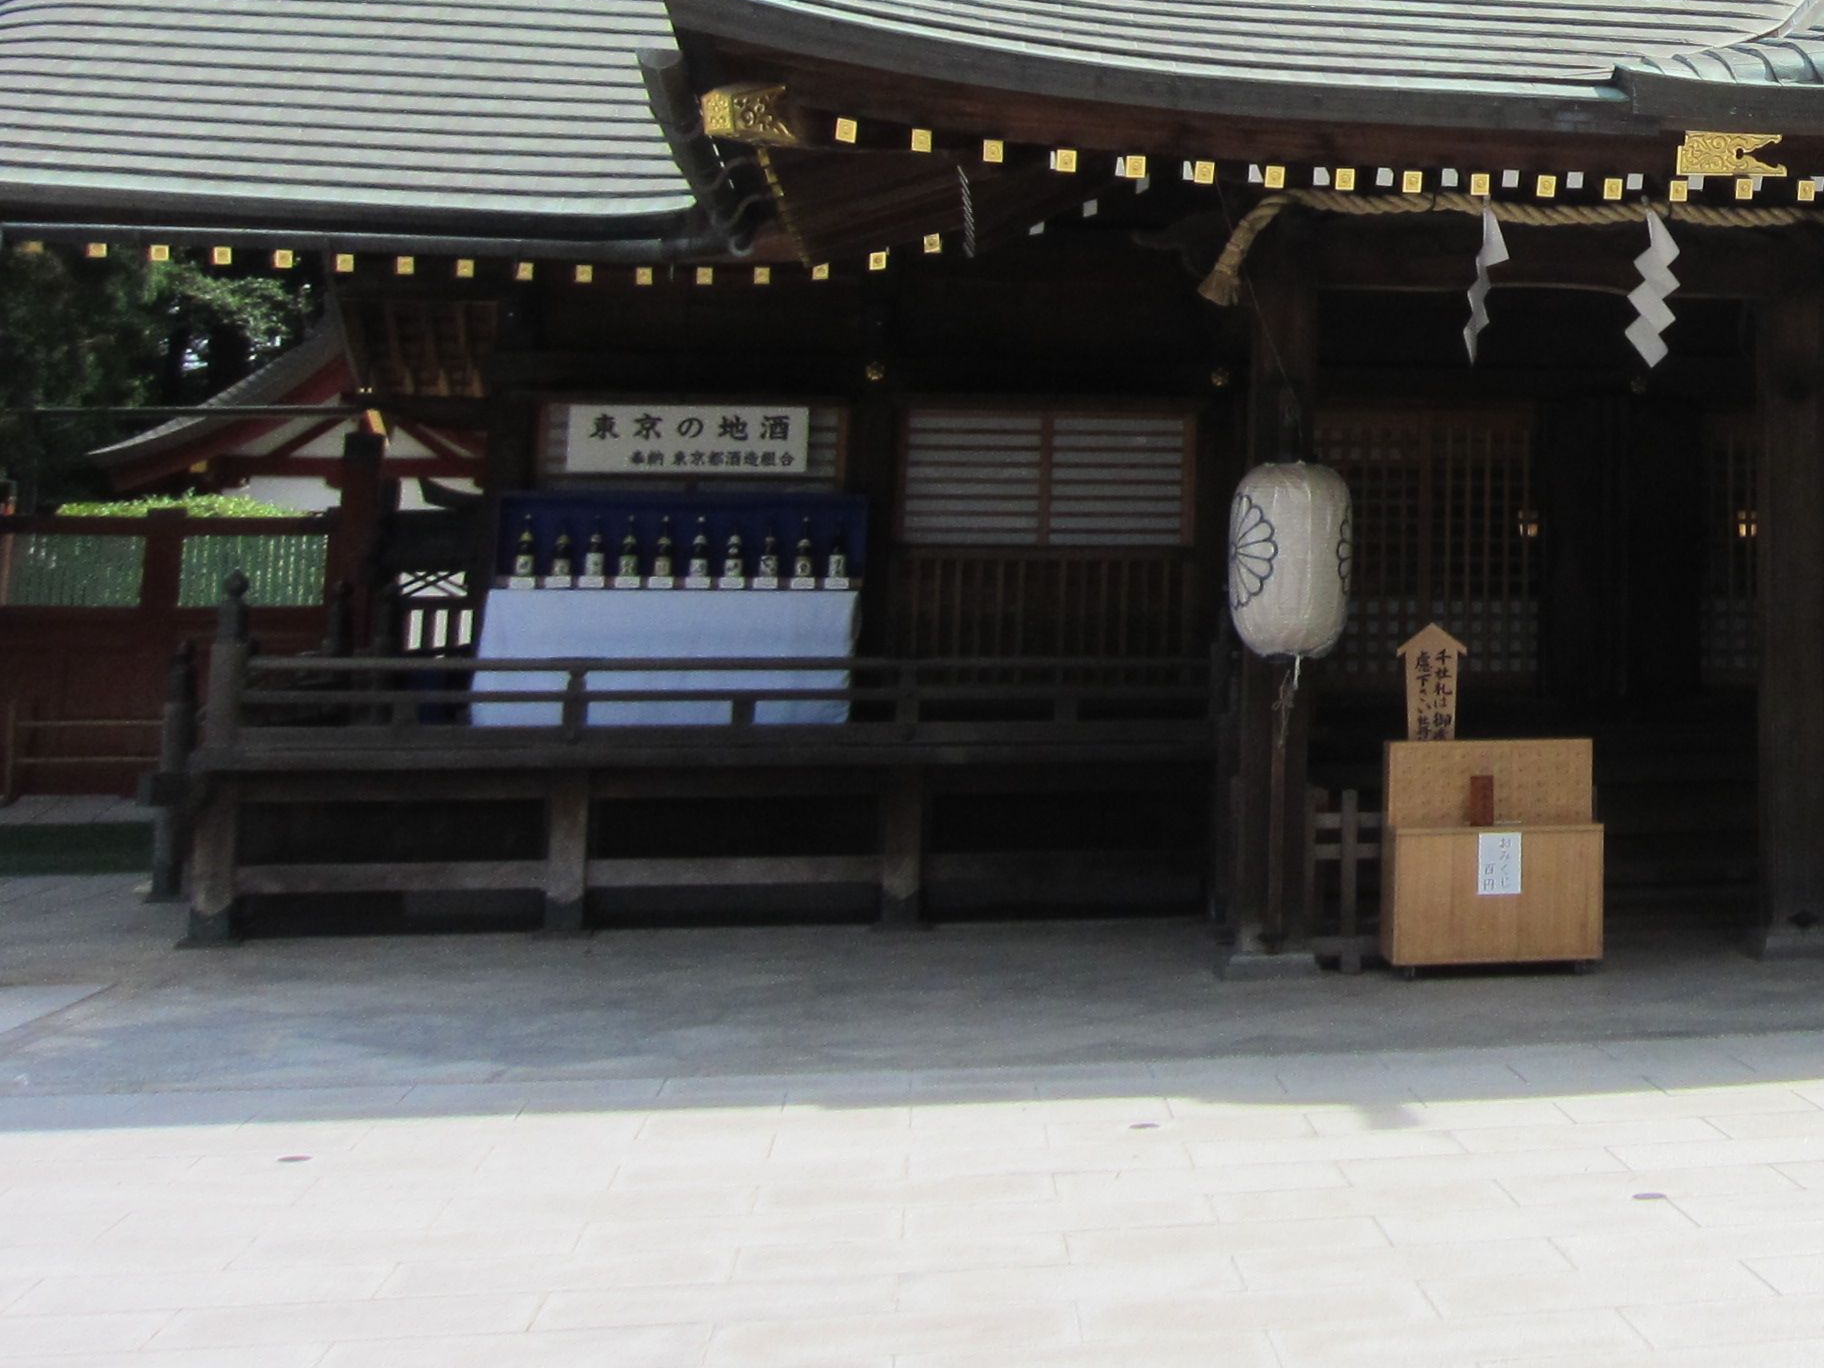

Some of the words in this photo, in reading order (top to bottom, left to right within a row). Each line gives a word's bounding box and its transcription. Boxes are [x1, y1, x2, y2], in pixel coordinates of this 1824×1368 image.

[589, 413, 791, 441] 東京の地酒
[629, 449, 665, 466] 奉納
[672, 450, 795, 467] 東京都酒造組合
[1483, 862, 1496, 891] 百円
[1499, 837, 1511, 889] おみくじ
